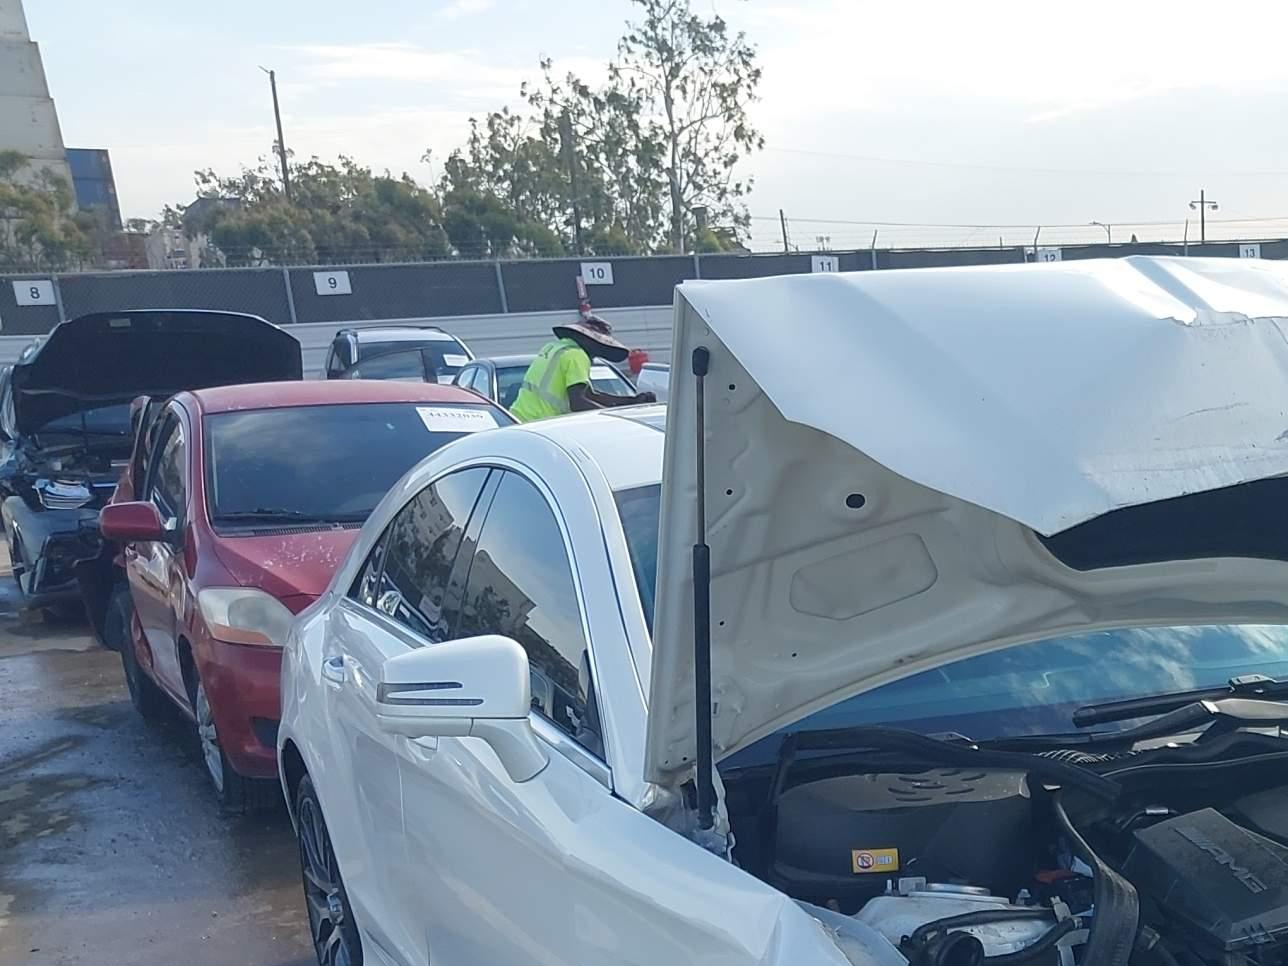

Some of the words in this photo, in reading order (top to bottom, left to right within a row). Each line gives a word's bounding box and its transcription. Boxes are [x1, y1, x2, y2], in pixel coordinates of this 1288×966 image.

[820, 261, 831, 271] 11
[589, 267, 605, 280] 10
[327, 277, 337, 289] 9
[30, 287, 40, 299] 8
